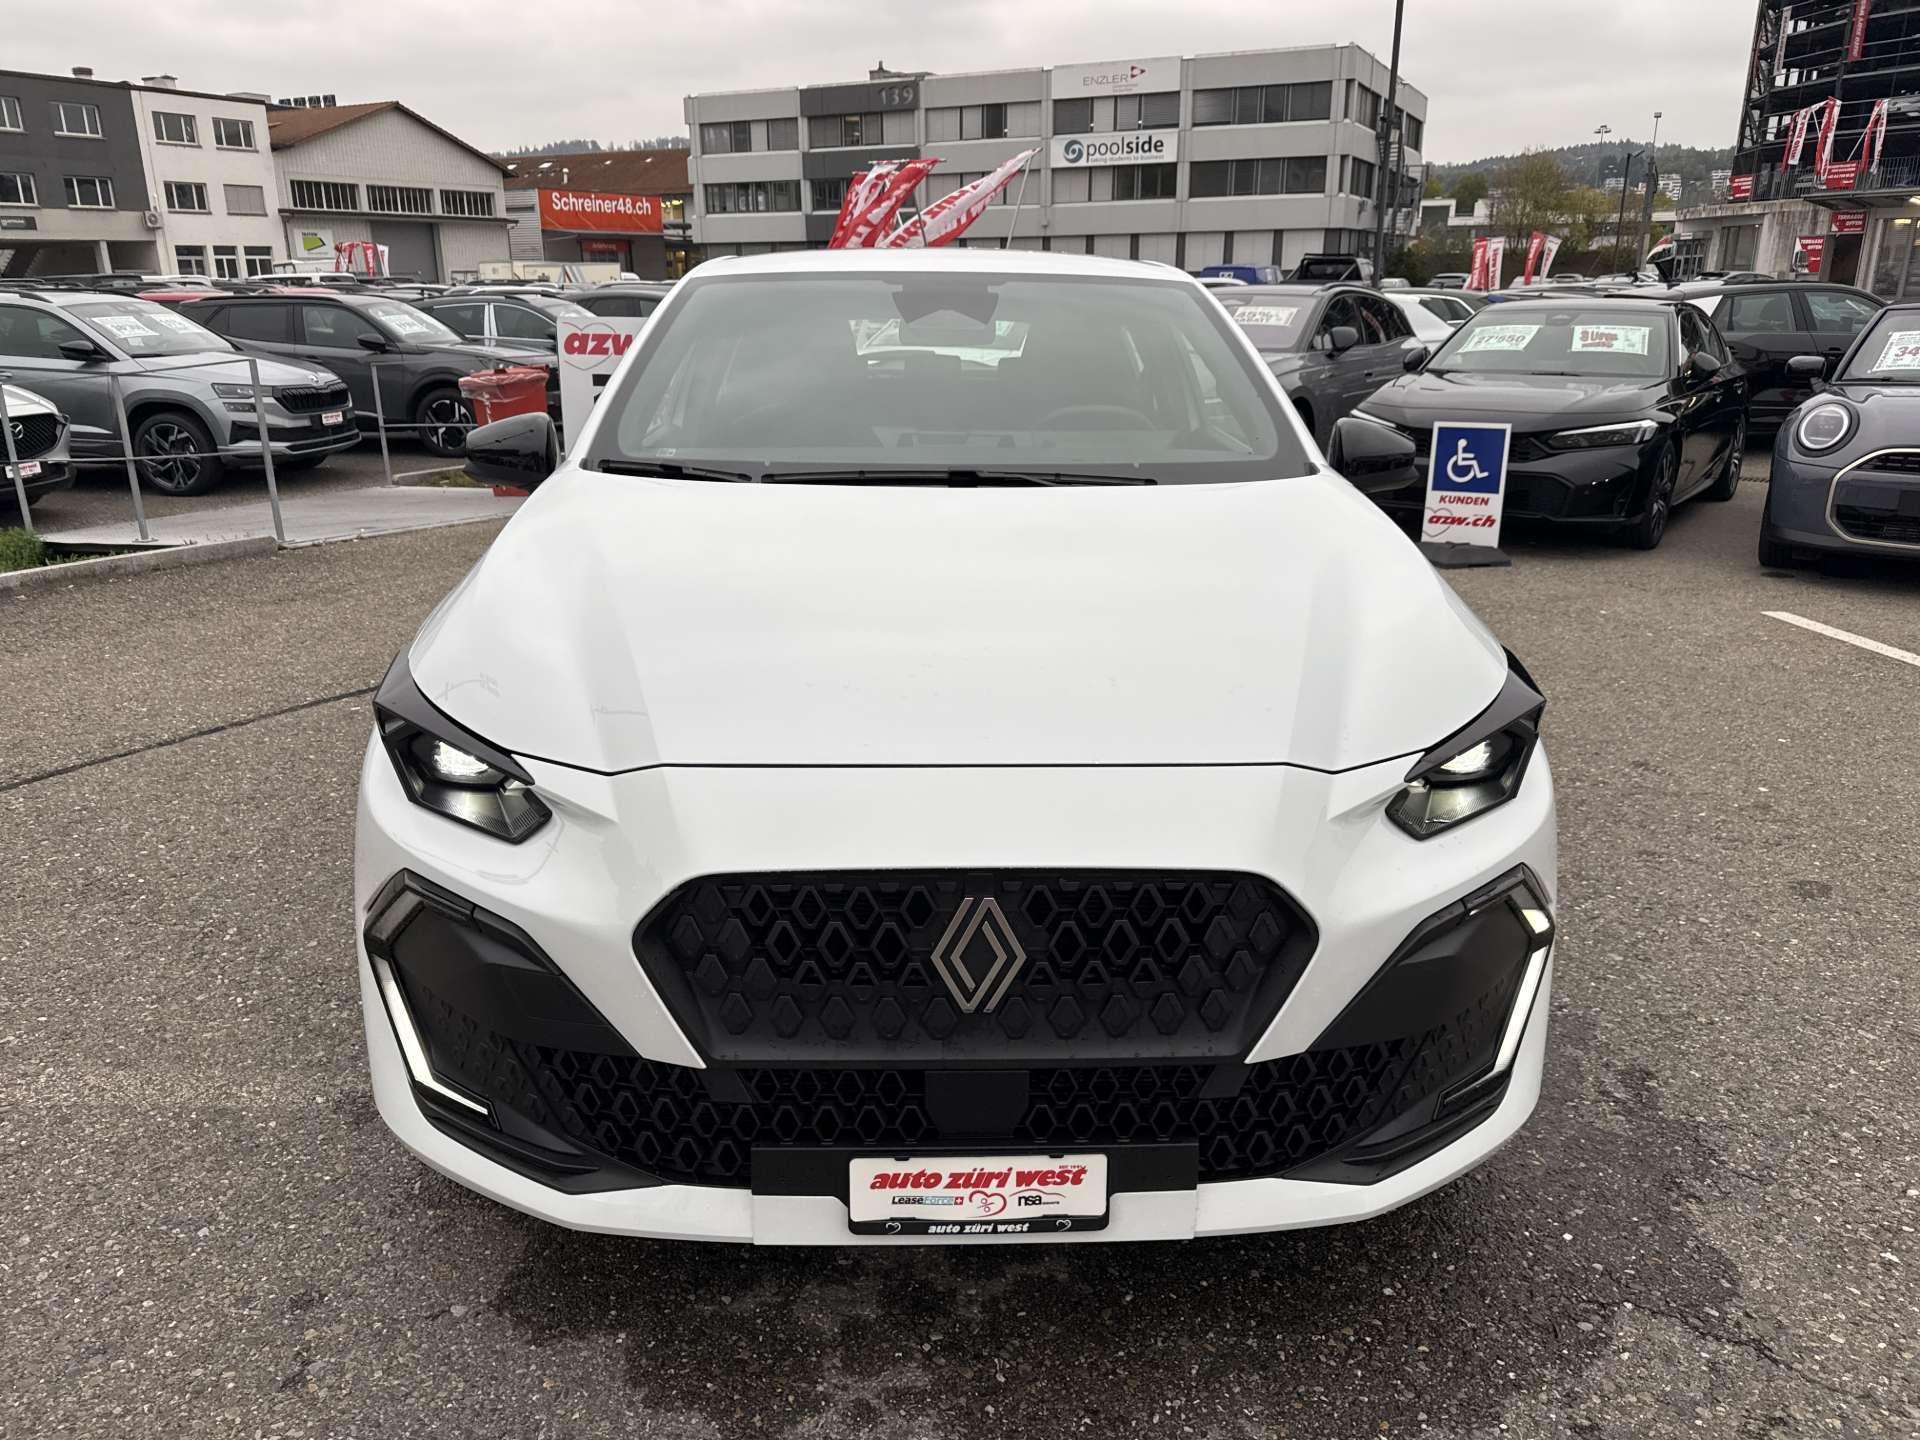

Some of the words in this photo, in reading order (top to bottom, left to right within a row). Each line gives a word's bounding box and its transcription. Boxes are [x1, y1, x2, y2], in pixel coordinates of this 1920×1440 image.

[1082, 74, 1128, 86] ENZLER
[881, 87, 914, 104] 139
[1086, 135, 1165, 163] poolside
[551, 192, 652, 215] Schreiner48.ch
[1439, 494, 1490, 506] KUNDEN
[1427, 515, 1497, 528] azw.ch
[870, 1168, 943, 1190] auto
[943, 1167, 1014, 1189] züri
[1016, 1167, 1087, 1188] west
[1018, 1195, 1042, 1207] nsa
[928, 1224, 956, 1234] auto
[957, 1222, 993, 1234] züri
[996, 1222, 1030, 1233] west
